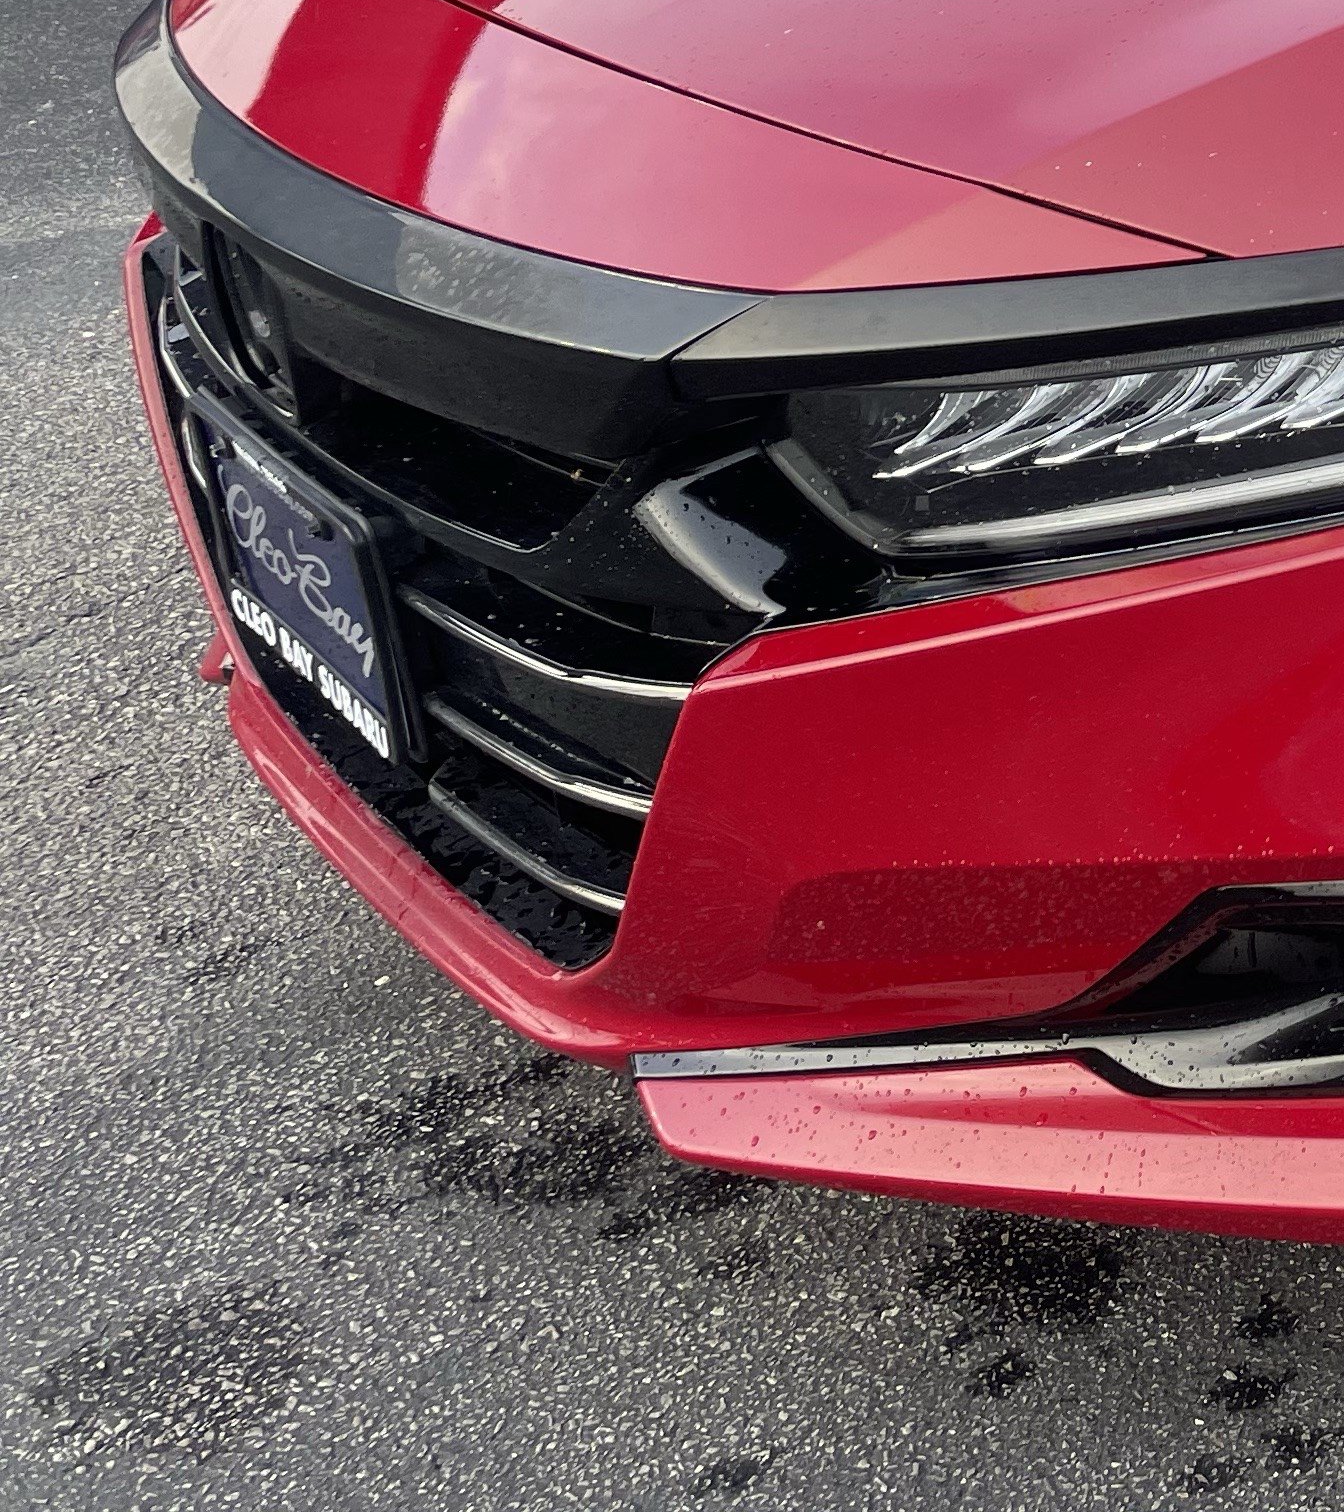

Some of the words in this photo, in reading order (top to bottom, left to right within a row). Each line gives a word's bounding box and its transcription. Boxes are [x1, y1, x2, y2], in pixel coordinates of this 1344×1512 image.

[217, 464, 296, 586] Cleo
[287, 527, 376, 678] Bay
[230, 588, 276, 647] CLEO
[279, 626, 315, 683] BAY
[317, 664, 390, 759] SUBARU
